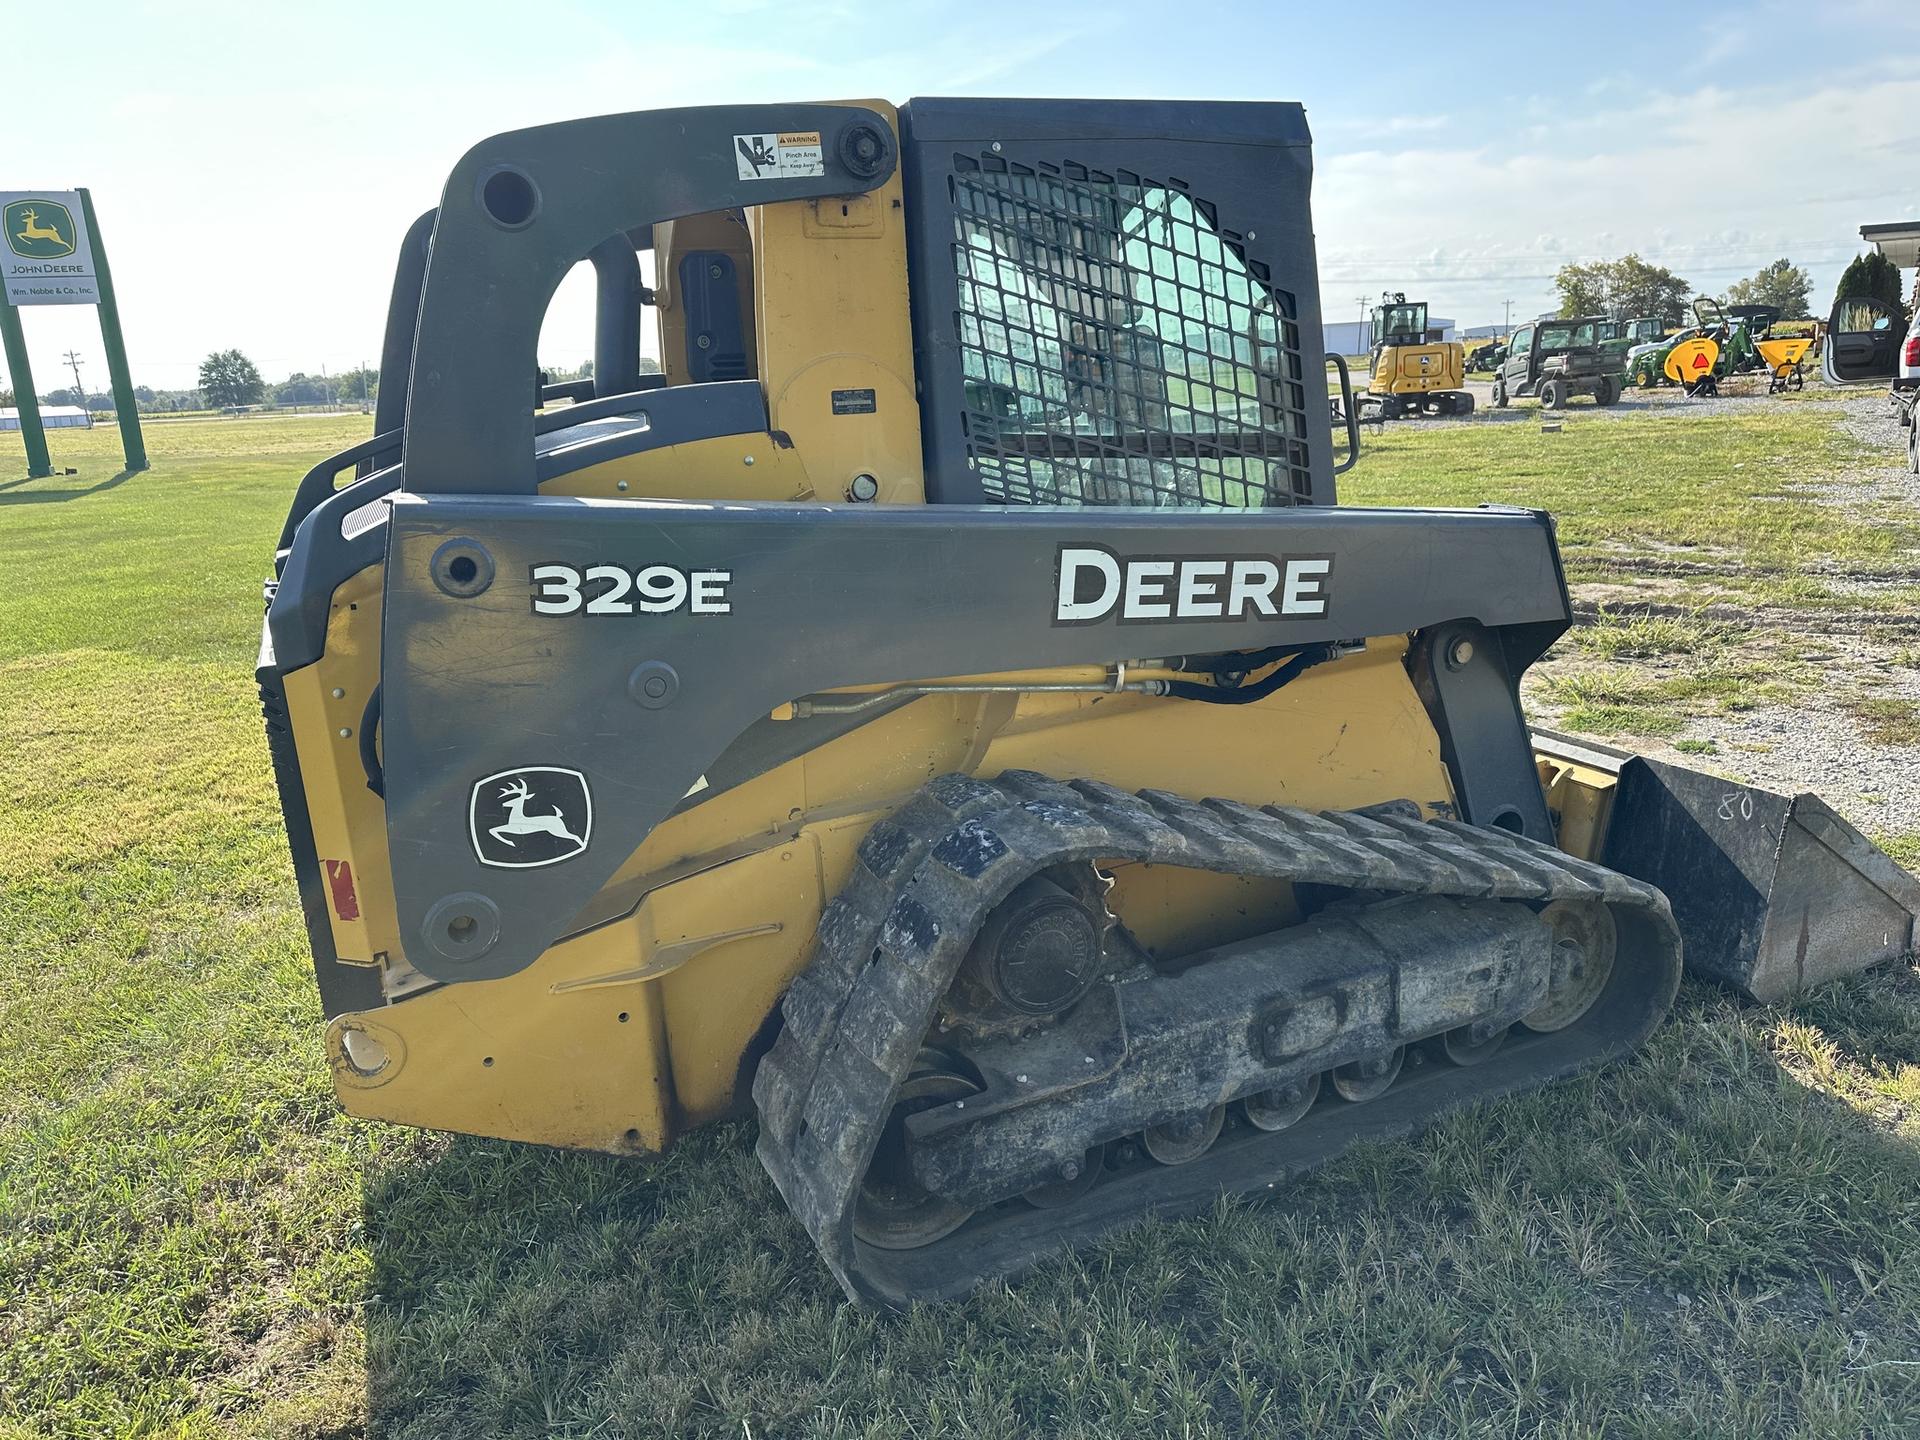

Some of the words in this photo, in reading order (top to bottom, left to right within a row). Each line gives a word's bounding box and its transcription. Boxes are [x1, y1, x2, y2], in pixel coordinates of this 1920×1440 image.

[11, 264, 42, 274] JOHN
[43, 264, 84, 273] DEERE
[11, 288, 29, 296] Wm.
[30, 287, 54, 295] Nobbe
[534, 565, 730, 614] 329E
[1057, 549, 1330, 620] DEERE
[1717, 790, 1753, 821] 80
